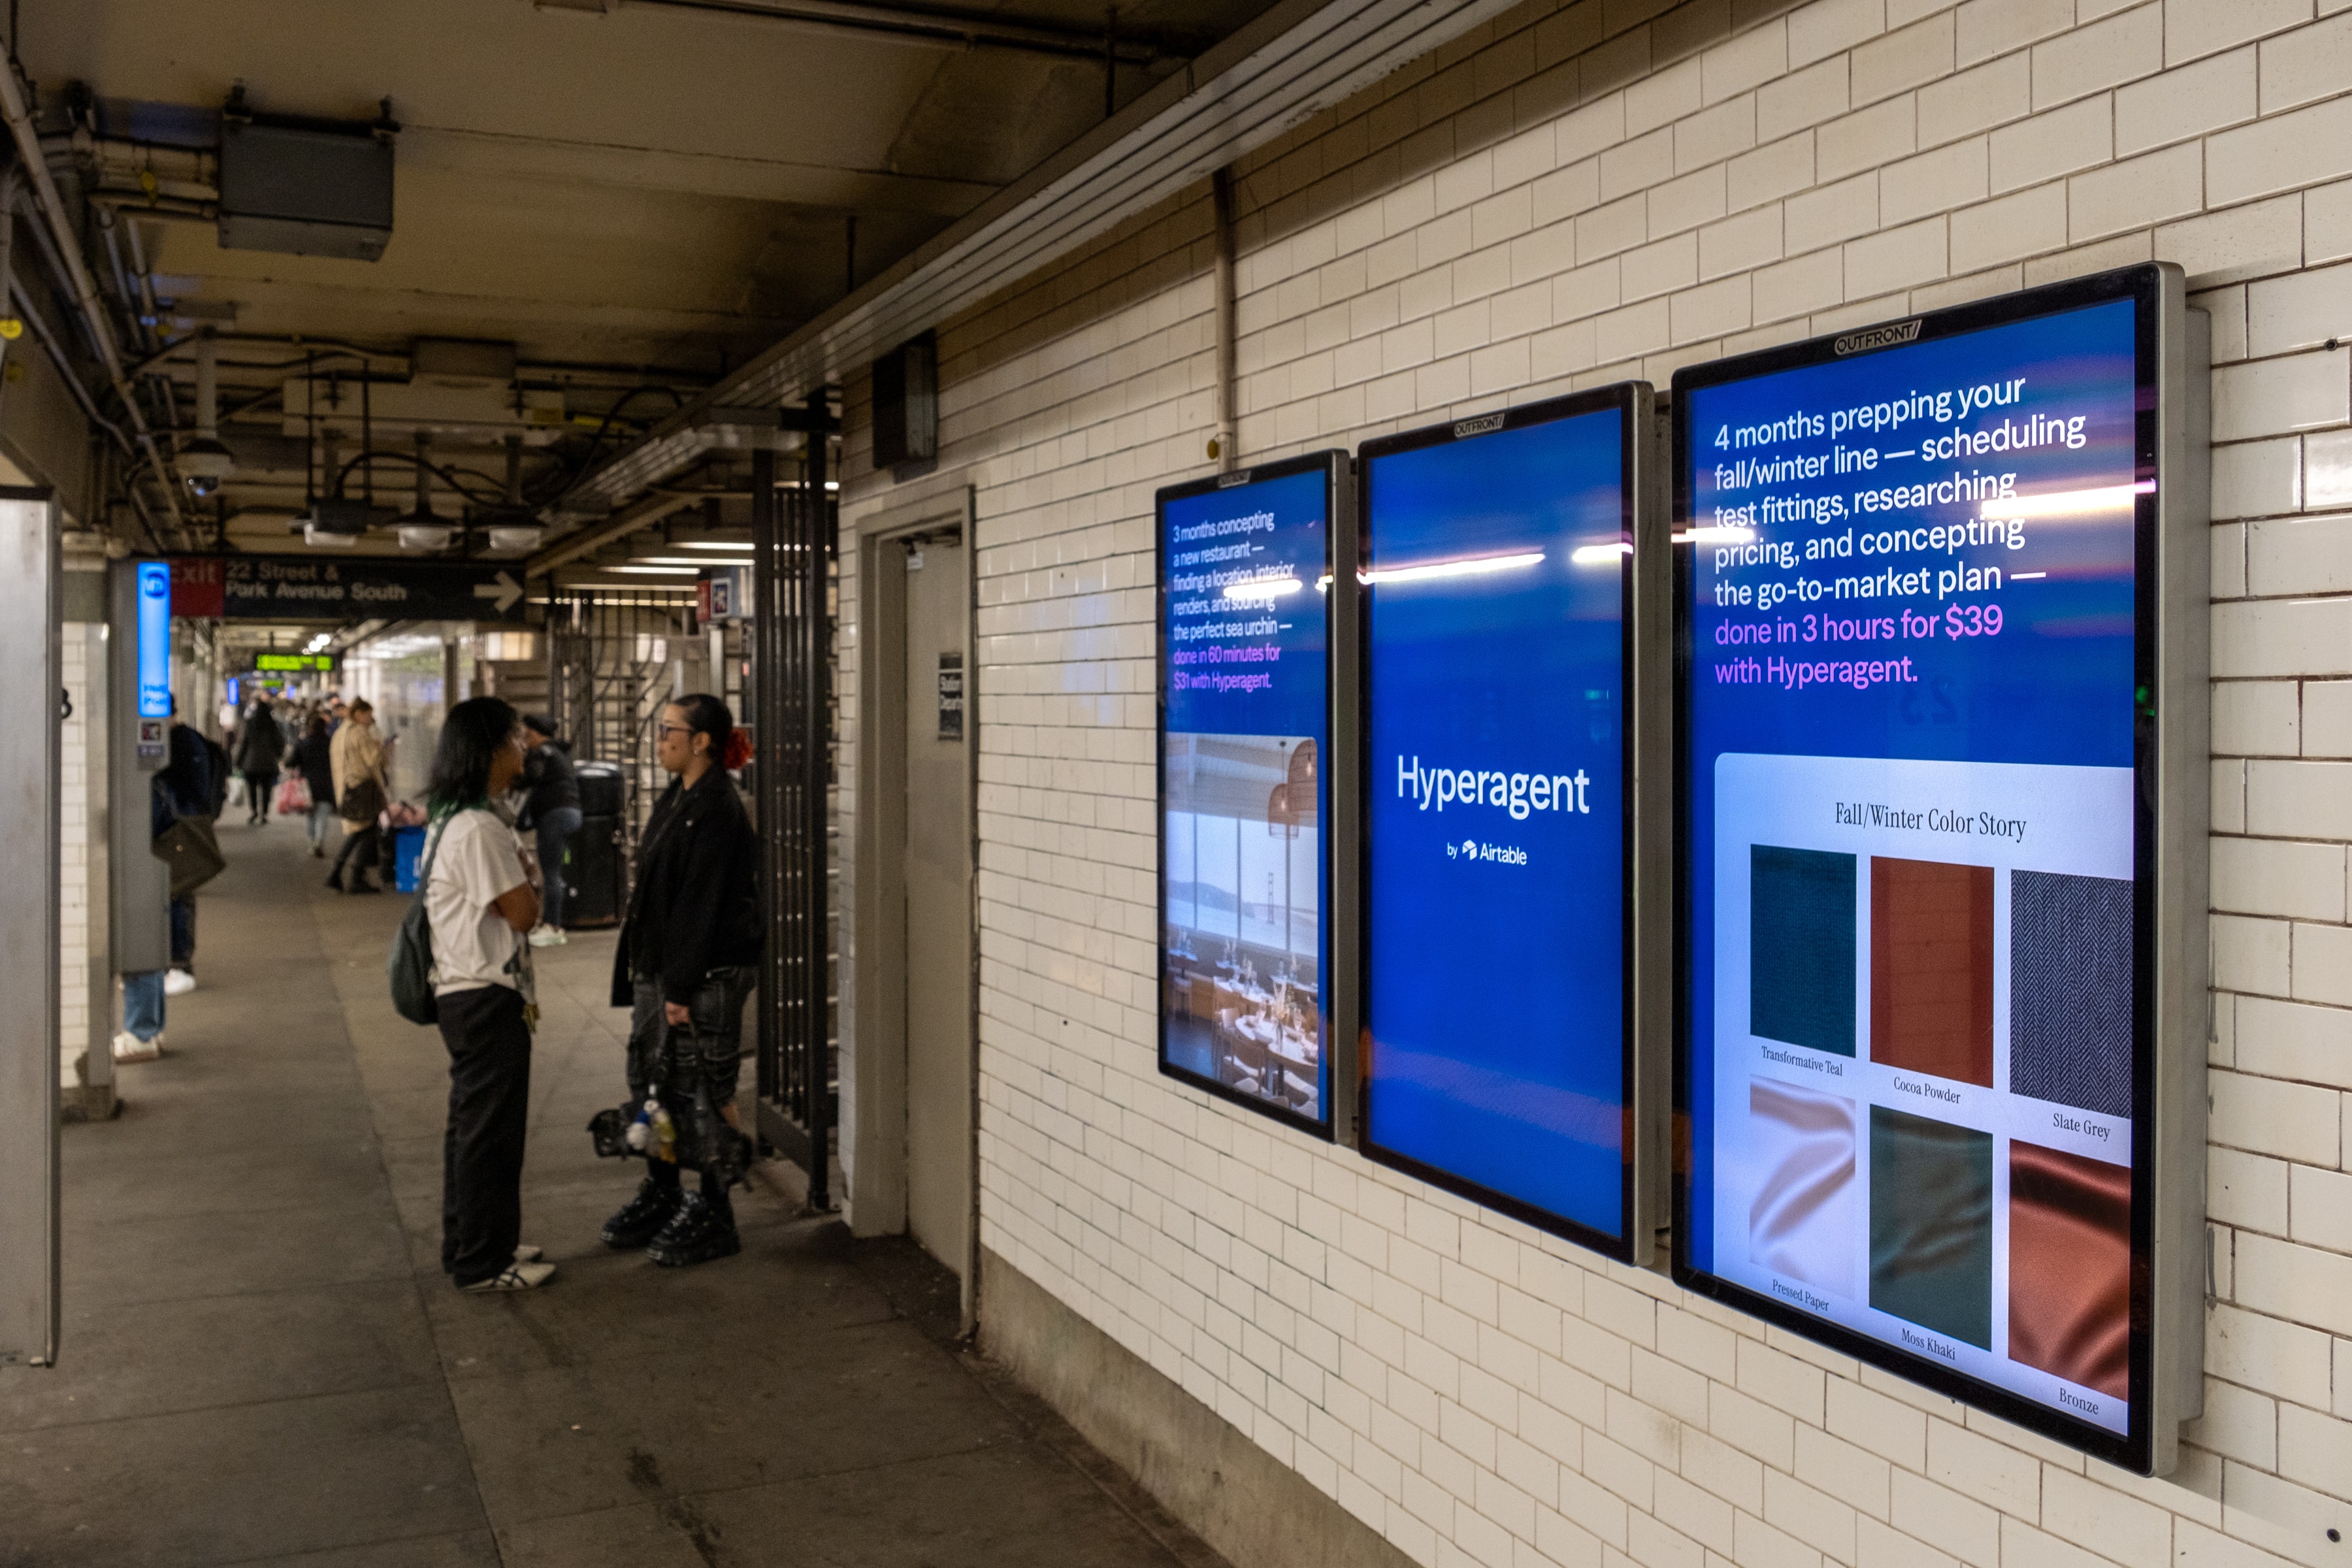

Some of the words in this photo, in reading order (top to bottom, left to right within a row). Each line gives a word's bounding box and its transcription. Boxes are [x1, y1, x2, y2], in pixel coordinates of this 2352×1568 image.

[1715, 425, 1730, 450] 4
[1735, 410, 1825, 449] months
[1831, 390, 1953, 440] prepping
[1957, 377, 2025, 419] your
[1715, 457, 1829, 490] fall/winter
[1835, 445, 1878, 474] line
[1921, 413, 2087, 462] scheduling
[1715, 500, 1757, 529] test
[1761, 493, 1849, 525] fittings,
[1854, 469, 2017, 514] researching
[1173, 525, 1181, 543] 3
[1181, 519, 1217, 542] months
[1217, 510, 1275, 535] concepting
[1173, 553, 1180, 568] a
[1180, 551, 1200, 566] new
[1200, 540, 1251, 563] restaurant
[1715, 537, 1800, 574] pricing,
[1805, 528, 1853, 560] and
[1859, 515, 2025, 555] concepting
[259, 562, 317, 581] Street
[1173, 572, 1205, 593] finding
[1205, 574, 1212, 587] a
[1256, 560, 1295, 581] interior
[1715, 580, 1752, 607] the
[1757, 566, 1931, 611] go-to-market
[1938, 561, 2001, 600] plan
[225, 581, 268, 599] Park
[275, 581, 345, 600] Avenue
[351, 582, 408, 601] South
[1173, 596, 1211, 617] renders,
[1211, 597, 1231, 613] and
[1231, 596, 1276, 613] sourcing
[1173, 623, 1190, 641] the
[1190, 621, 1224, 644] perfect
[1225, 624, 1243, 638] sea
[1244, 615, 1278, 636] urchin
[1715, 619, 1772, 645] done
[1777, 616, 1797, 643] in
[1802, 613, 1818, 642] 3
[1823, 613, 1895, 642] hours
[1901, 608, 1940, 639] for
[1945, 602, 2003, 641] $39
[1173, 647, 1198, 665] done
[1198, 645, 1207, 664] in
[1208, 645, 1222, 664] 60
[1223, 644, 1264, 663] minutes
[1265, 642, 1281, 661] for
[1190, 670, 1211, 690] with
[1211, 670, 1273, 693] Hyperagent.
[1715, 656, 1761, 684] with
[1767, 656, 1918, 690] Hyperagent.
[1398, 755, 1590, 821] Hyperagent
[1835, 802, 1923, 830] Fall/Winter
[1928, 808, 1974, 834] Color
[1979, 811, 2027, 843] Story
[1447, 841, 1458, 860] by
[1479, 842, 1527, 866] Airtable
[1761, 1045, 1824, 1072] Transformative
[1825, 1060, 1843, 1077] Teal
[1893, 1076, 1922, 1095] Cocoa
[1924, 1083, 1961, 1104] Powder
[2053, 1113, 2080, 1132] Slate
[2083, 1120, 2110, 1142] Grey
[1772, 1279, 1803, 1301] Pressed
[1805, 1291, 1829, 1311] Paper
[1901, 1327, 1925, 1348] Moss
[1927, 1337, 1955, 1361] Khaki
[2059, 1387, 2099, 1415] Bronze
